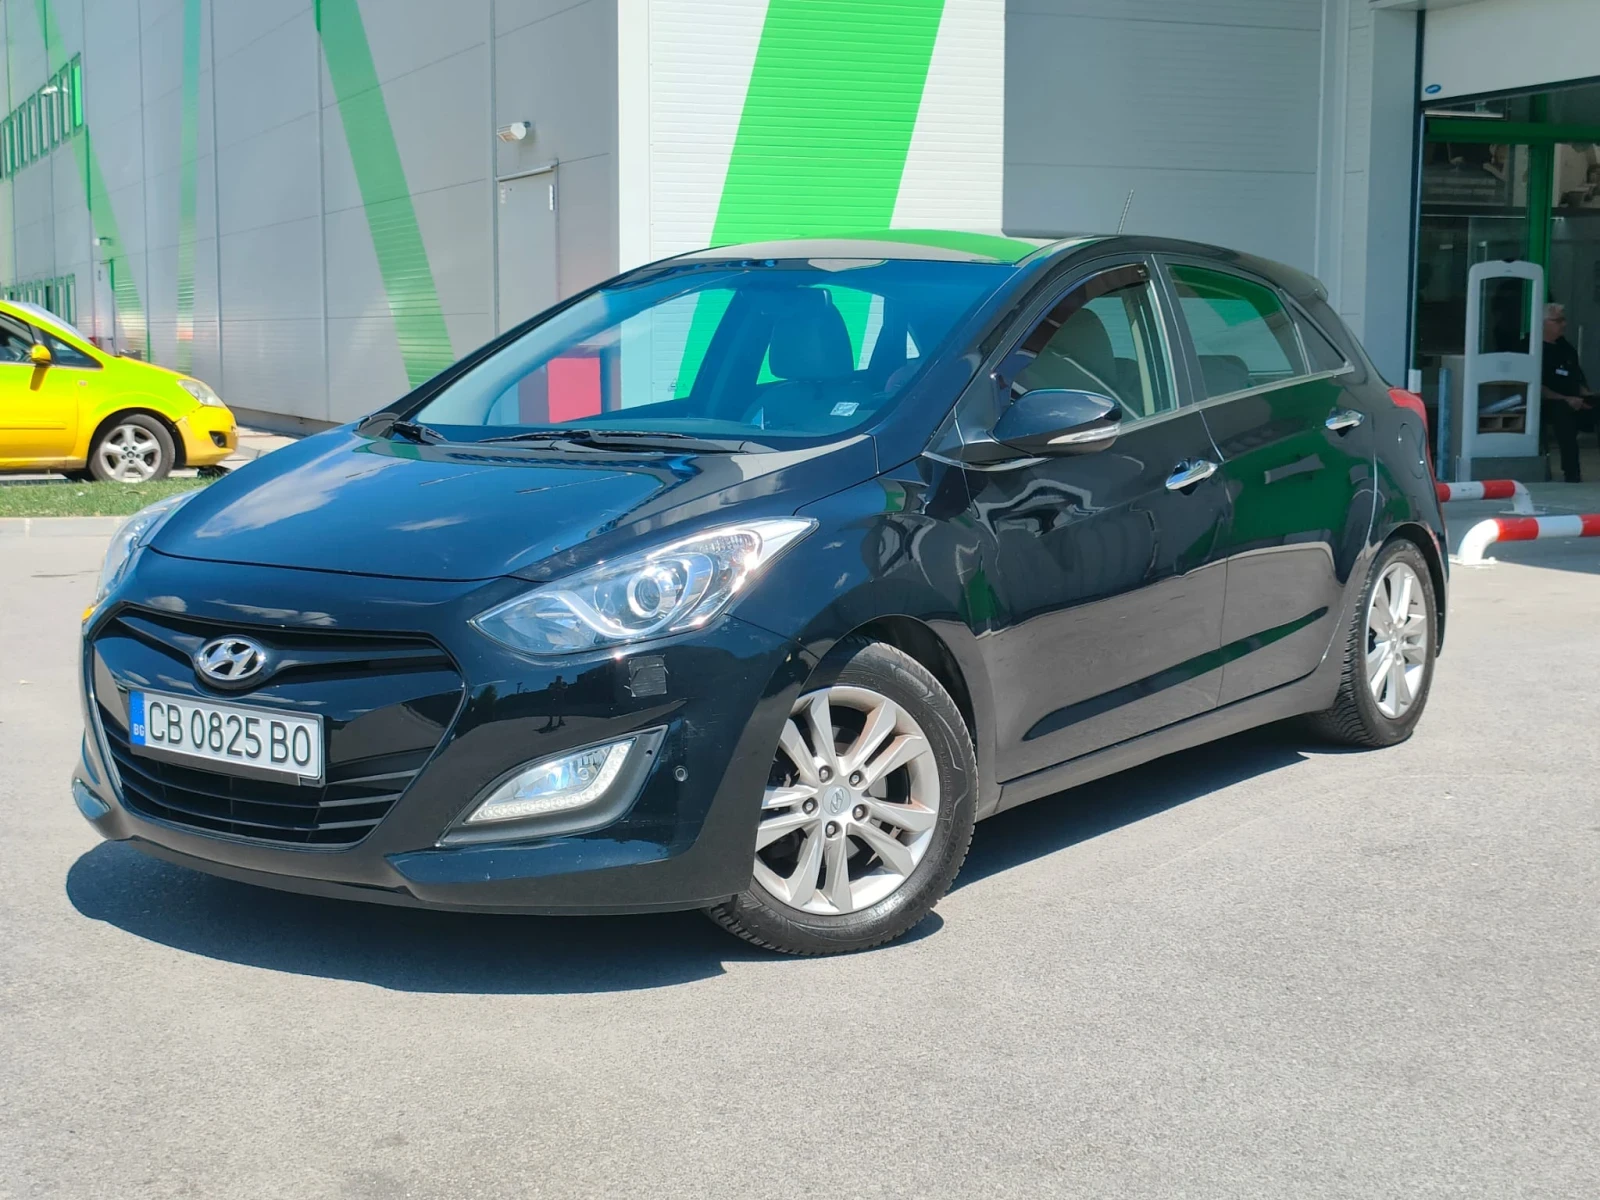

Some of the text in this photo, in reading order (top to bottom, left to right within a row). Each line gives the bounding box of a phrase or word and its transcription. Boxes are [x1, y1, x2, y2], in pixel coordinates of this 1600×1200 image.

[133, 723, 145, 737] BG
[149, 701, 311, 767] CB 0825 BO
